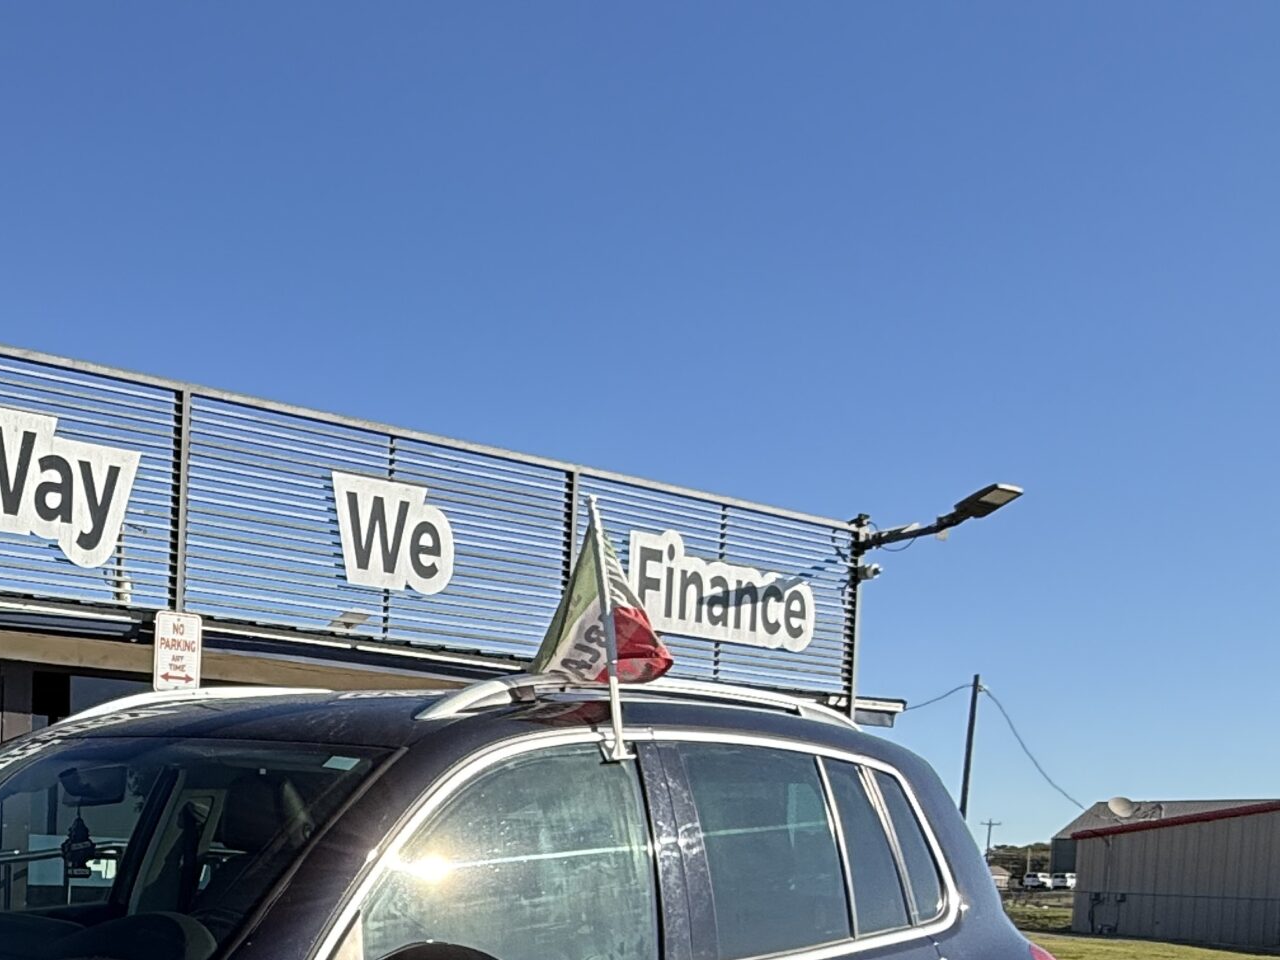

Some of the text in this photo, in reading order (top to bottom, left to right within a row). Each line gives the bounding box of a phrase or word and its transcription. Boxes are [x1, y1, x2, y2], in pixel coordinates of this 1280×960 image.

[345, 491, 808, 639] We Finance
[172, 622, 185, 635] NO
[160, 637, 197, 653] PARKING
[168, 663, 187, 673] TIME
